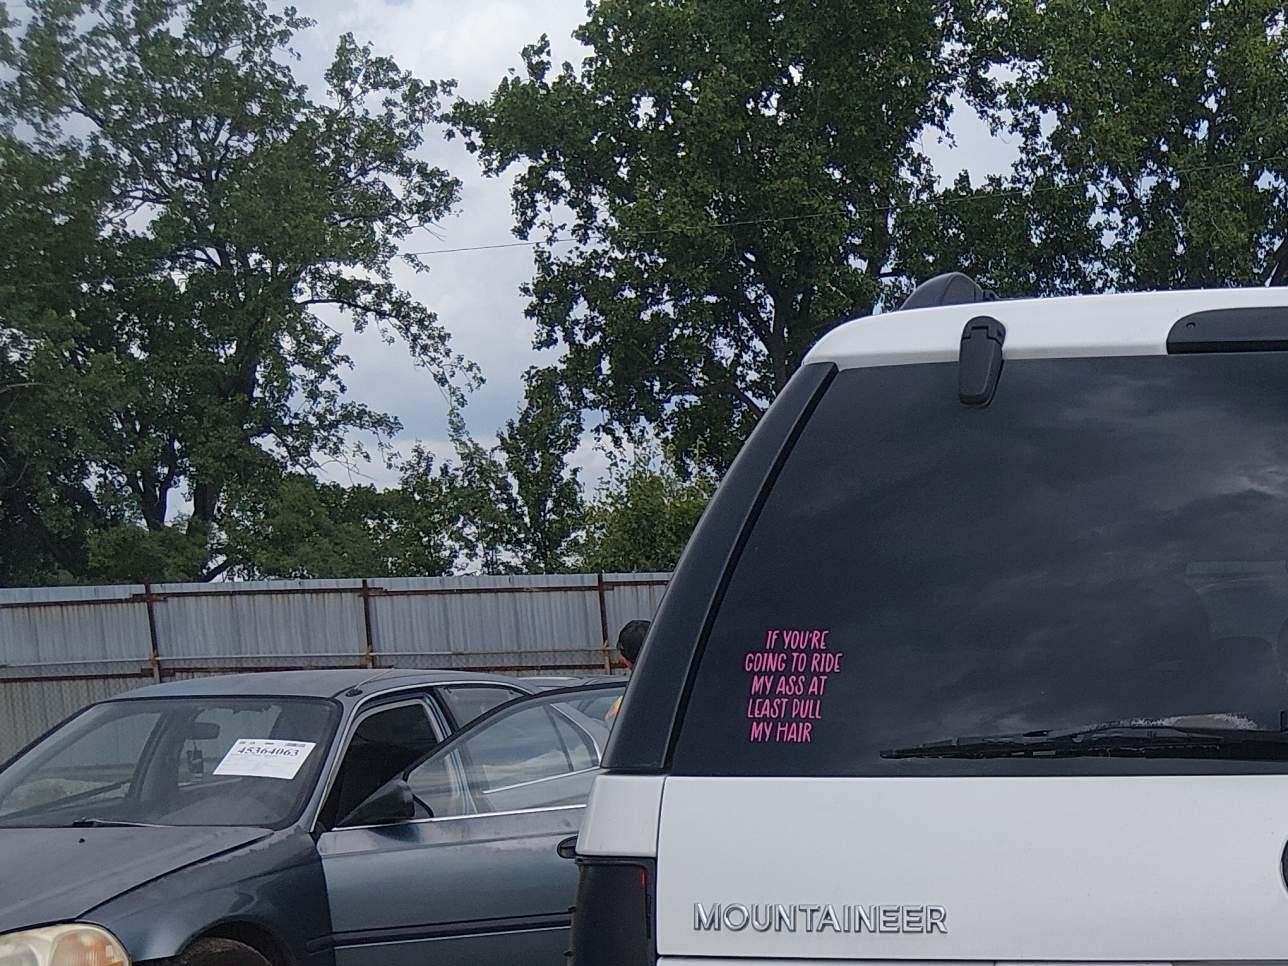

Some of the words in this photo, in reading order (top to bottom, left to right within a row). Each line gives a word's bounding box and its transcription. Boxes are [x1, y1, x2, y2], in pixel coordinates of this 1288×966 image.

[766, 630, 780, 650] IF
[782, 630, 829, 650] YOU'RE
[745, 653, 787, 672] GOING
[791, 652, 807, 673] TO
[811, 652, 843, 673] RIDE
[751, 675, 774, 695] MY
[775, 675, 806, 695] ASS
[808, 676, 828, 696] AT
[747, 698, 789, 718] LEAST
[792, 698, 822, 719] PULL
[750, 722, 773, 742] MY
[776, 722, 812, 742] HAIR
[693, 902, 948, 934] MOUNTAINEER
